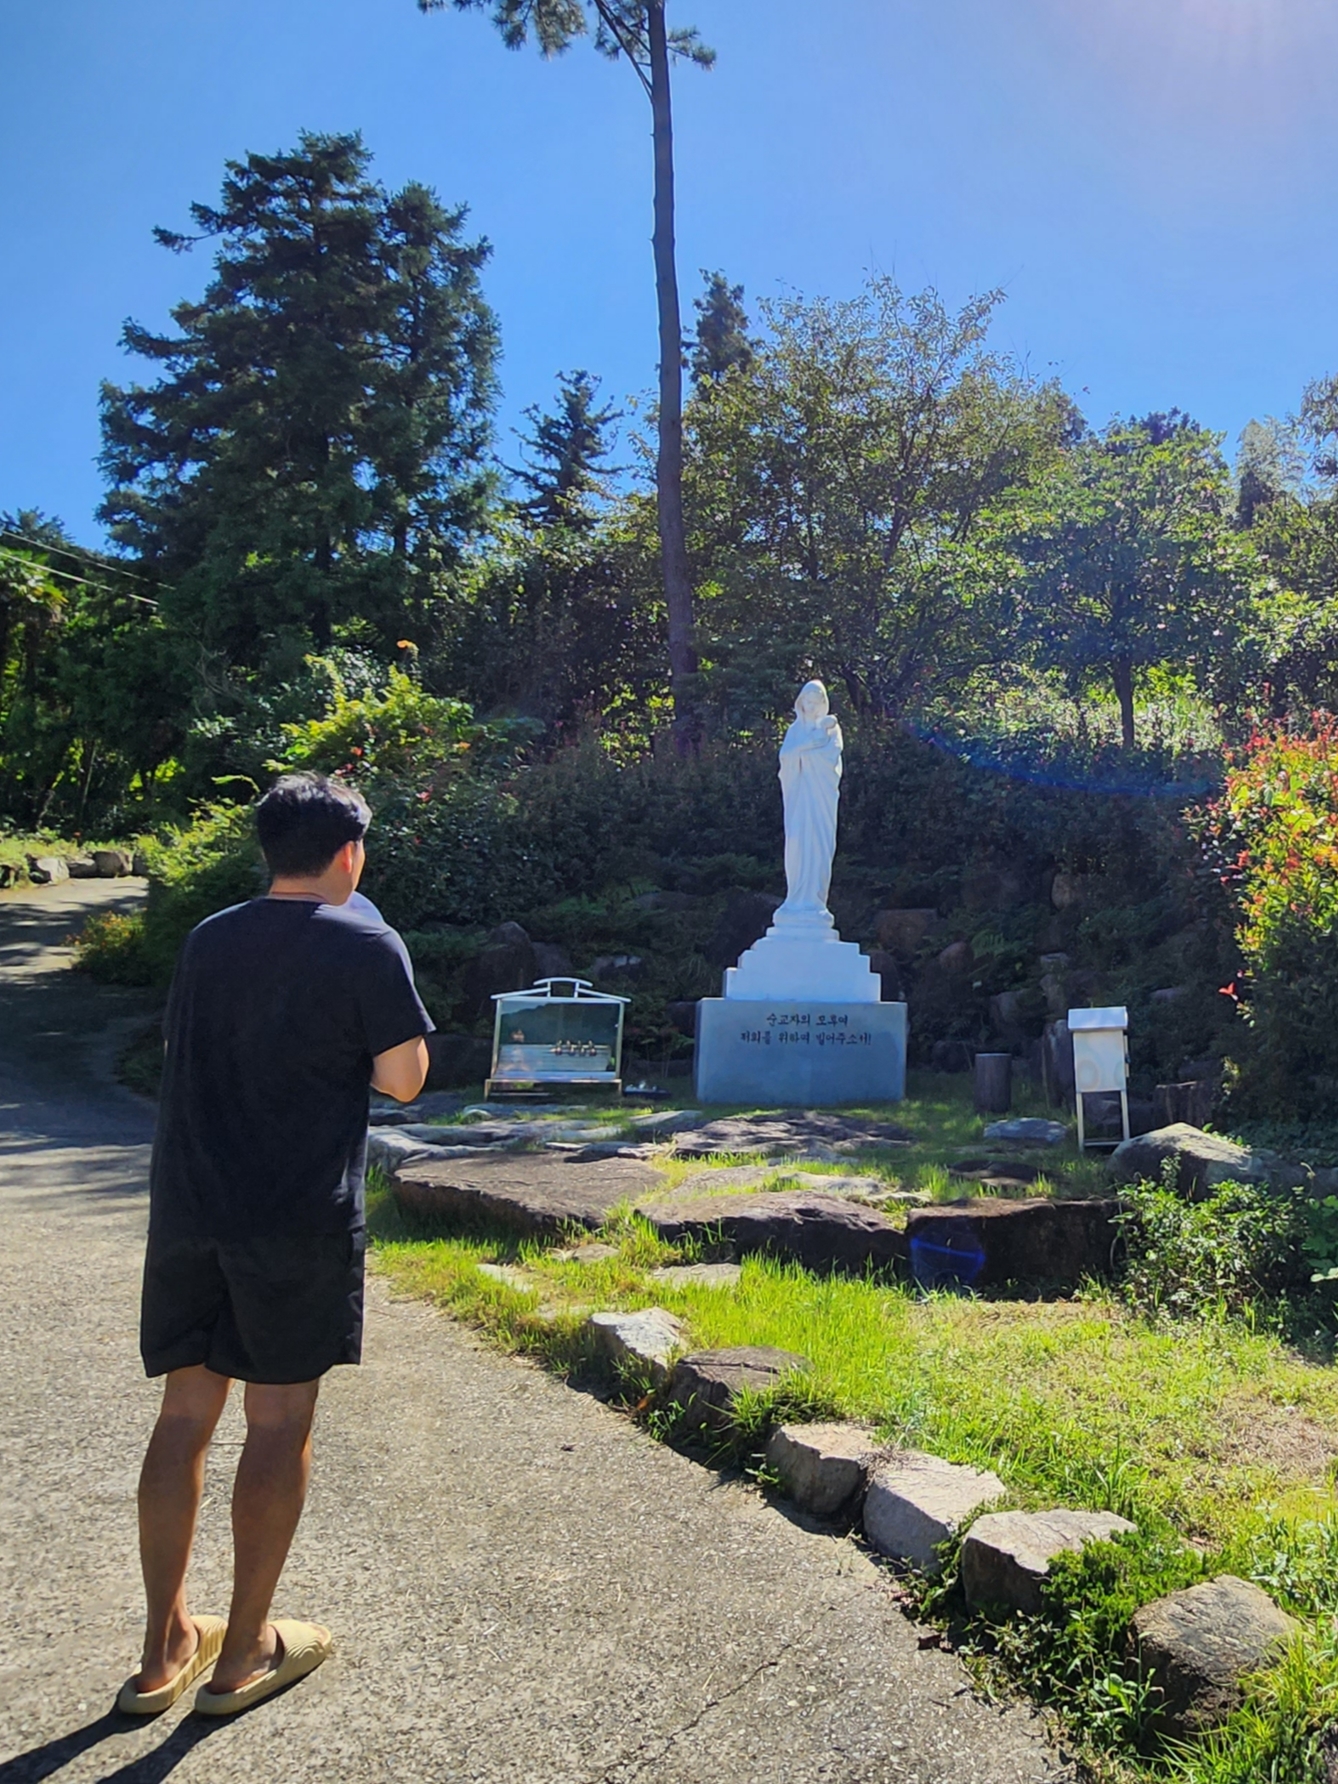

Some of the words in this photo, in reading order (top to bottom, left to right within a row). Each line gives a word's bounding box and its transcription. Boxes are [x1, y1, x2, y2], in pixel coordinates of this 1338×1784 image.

[766, 1013, 811, 1026] 순교자의
[815, 1013, 848, 1026] 모후여
[740, 1030, 772, 1045] 저희를
[778, 1031, 810, 1044] 위하여
